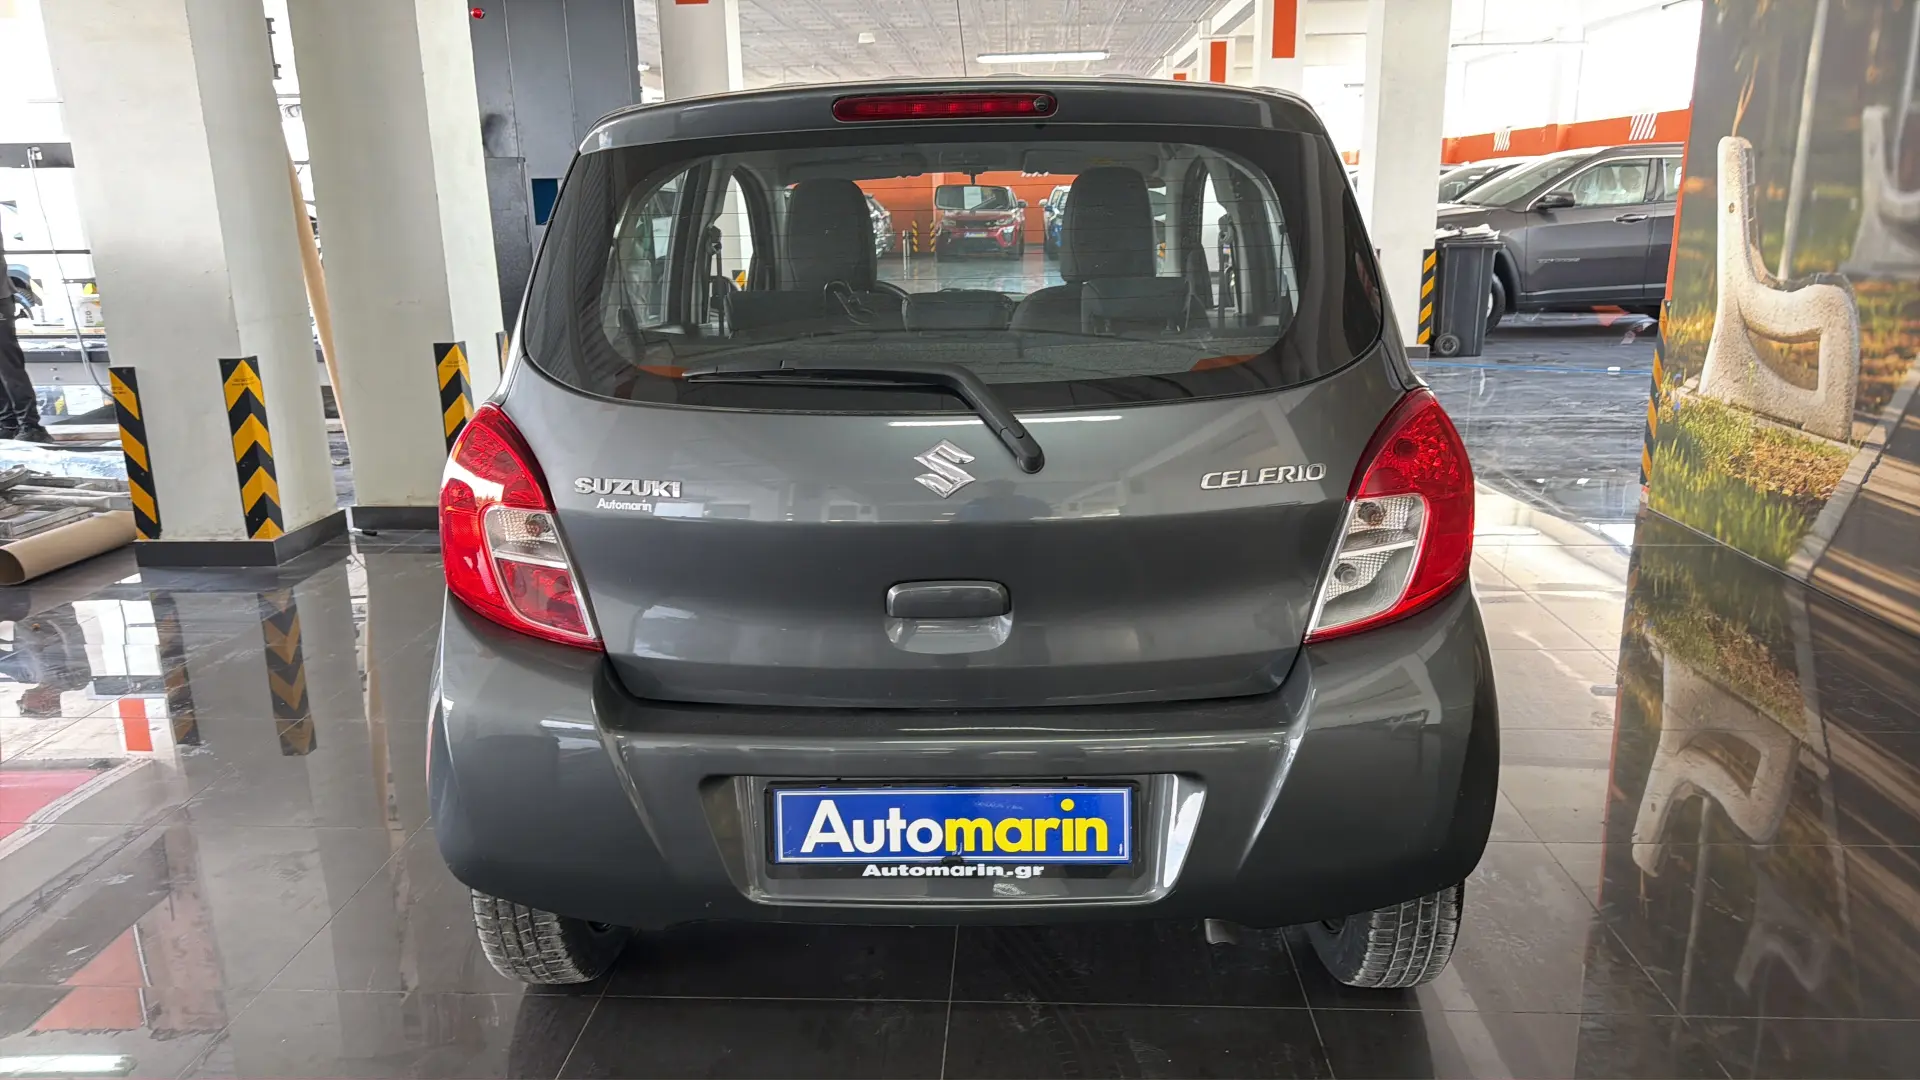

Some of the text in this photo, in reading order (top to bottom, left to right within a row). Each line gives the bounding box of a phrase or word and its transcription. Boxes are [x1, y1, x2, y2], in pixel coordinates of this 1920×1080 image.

[1200, 462, 1327, 490] CELERIO
[574, 477, 682, 498] SUZUKI
[596, 498, 653, 512] Automarin
[800, 798, 1108, 853] Automarin
[862, 863, 1045, 879] Automarin.gr
